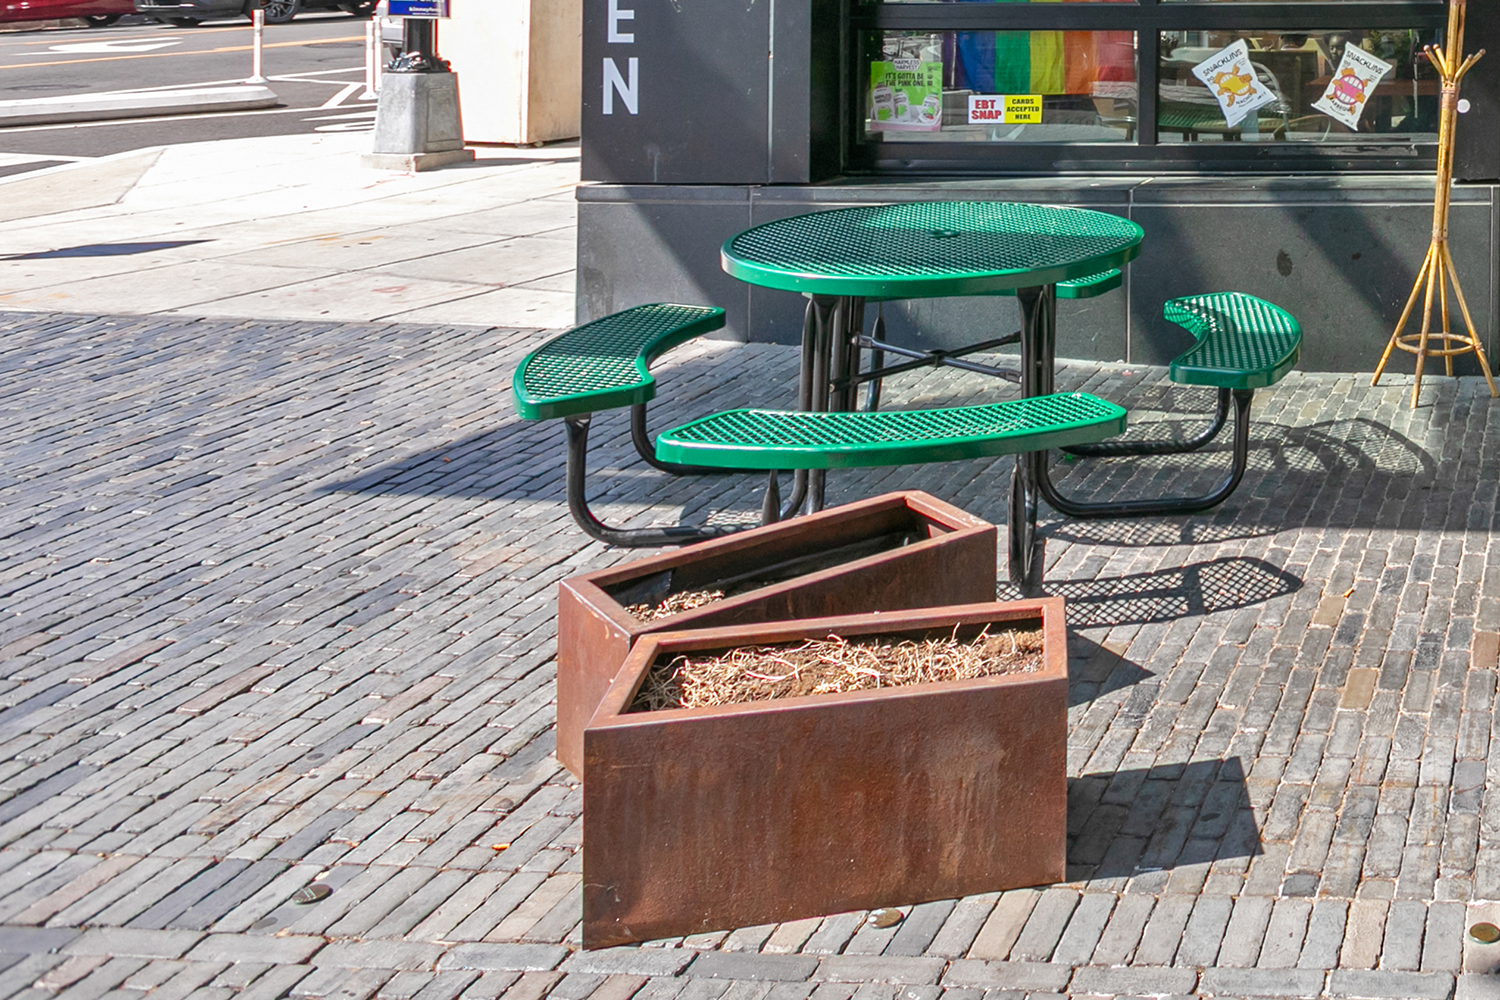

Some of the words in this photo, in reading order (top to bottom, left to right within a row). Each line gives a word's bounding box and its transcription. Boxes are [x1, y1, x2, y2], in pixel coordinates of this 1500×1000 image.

[1202, 48, 1243, 77] SNACKLINS
[1345, 50, 1384, 75] SNACKLINS
[885, 72, 897, 80] IT'S
[898, 72, 915, 80] GOTTA
[917, 72, 924, 80] BE
[974, 99, 996, 109] EBT
[971, 110, 1002, 120] SNAP
